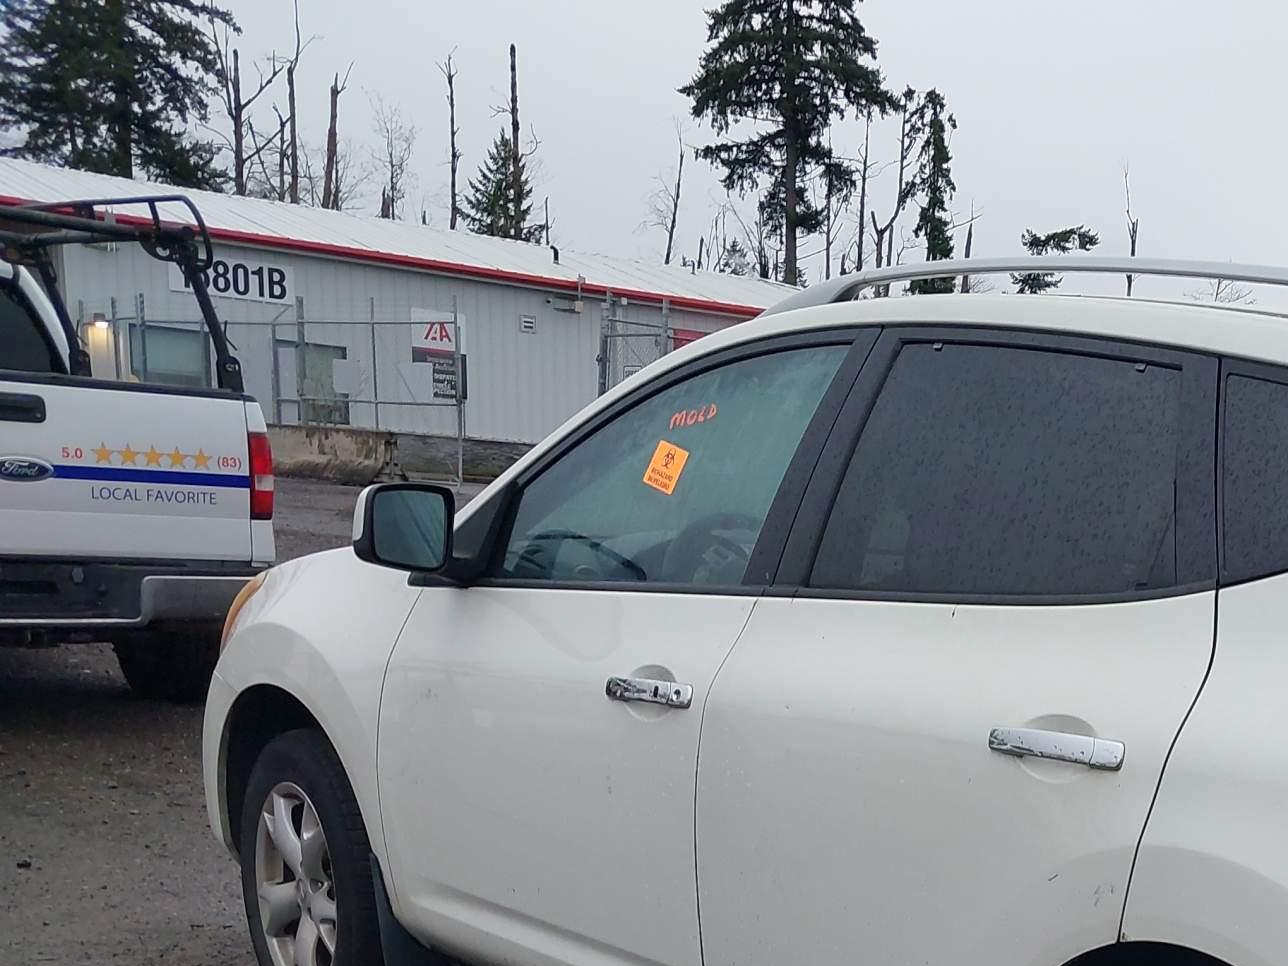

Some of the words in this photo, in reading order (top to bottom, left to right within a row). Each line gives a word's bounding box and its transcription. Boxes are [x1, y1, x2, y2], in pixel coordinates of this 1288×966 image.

[669, 403, 718, 430] MOLD
[2, 460, 39, 475] Ford
[61, 447, 83, 459] 5.0
[217, 456, 241, 472] (83)
[91, 486, 141, 501] LOCAL
[146, 489, 217, 505] FAVORITE
